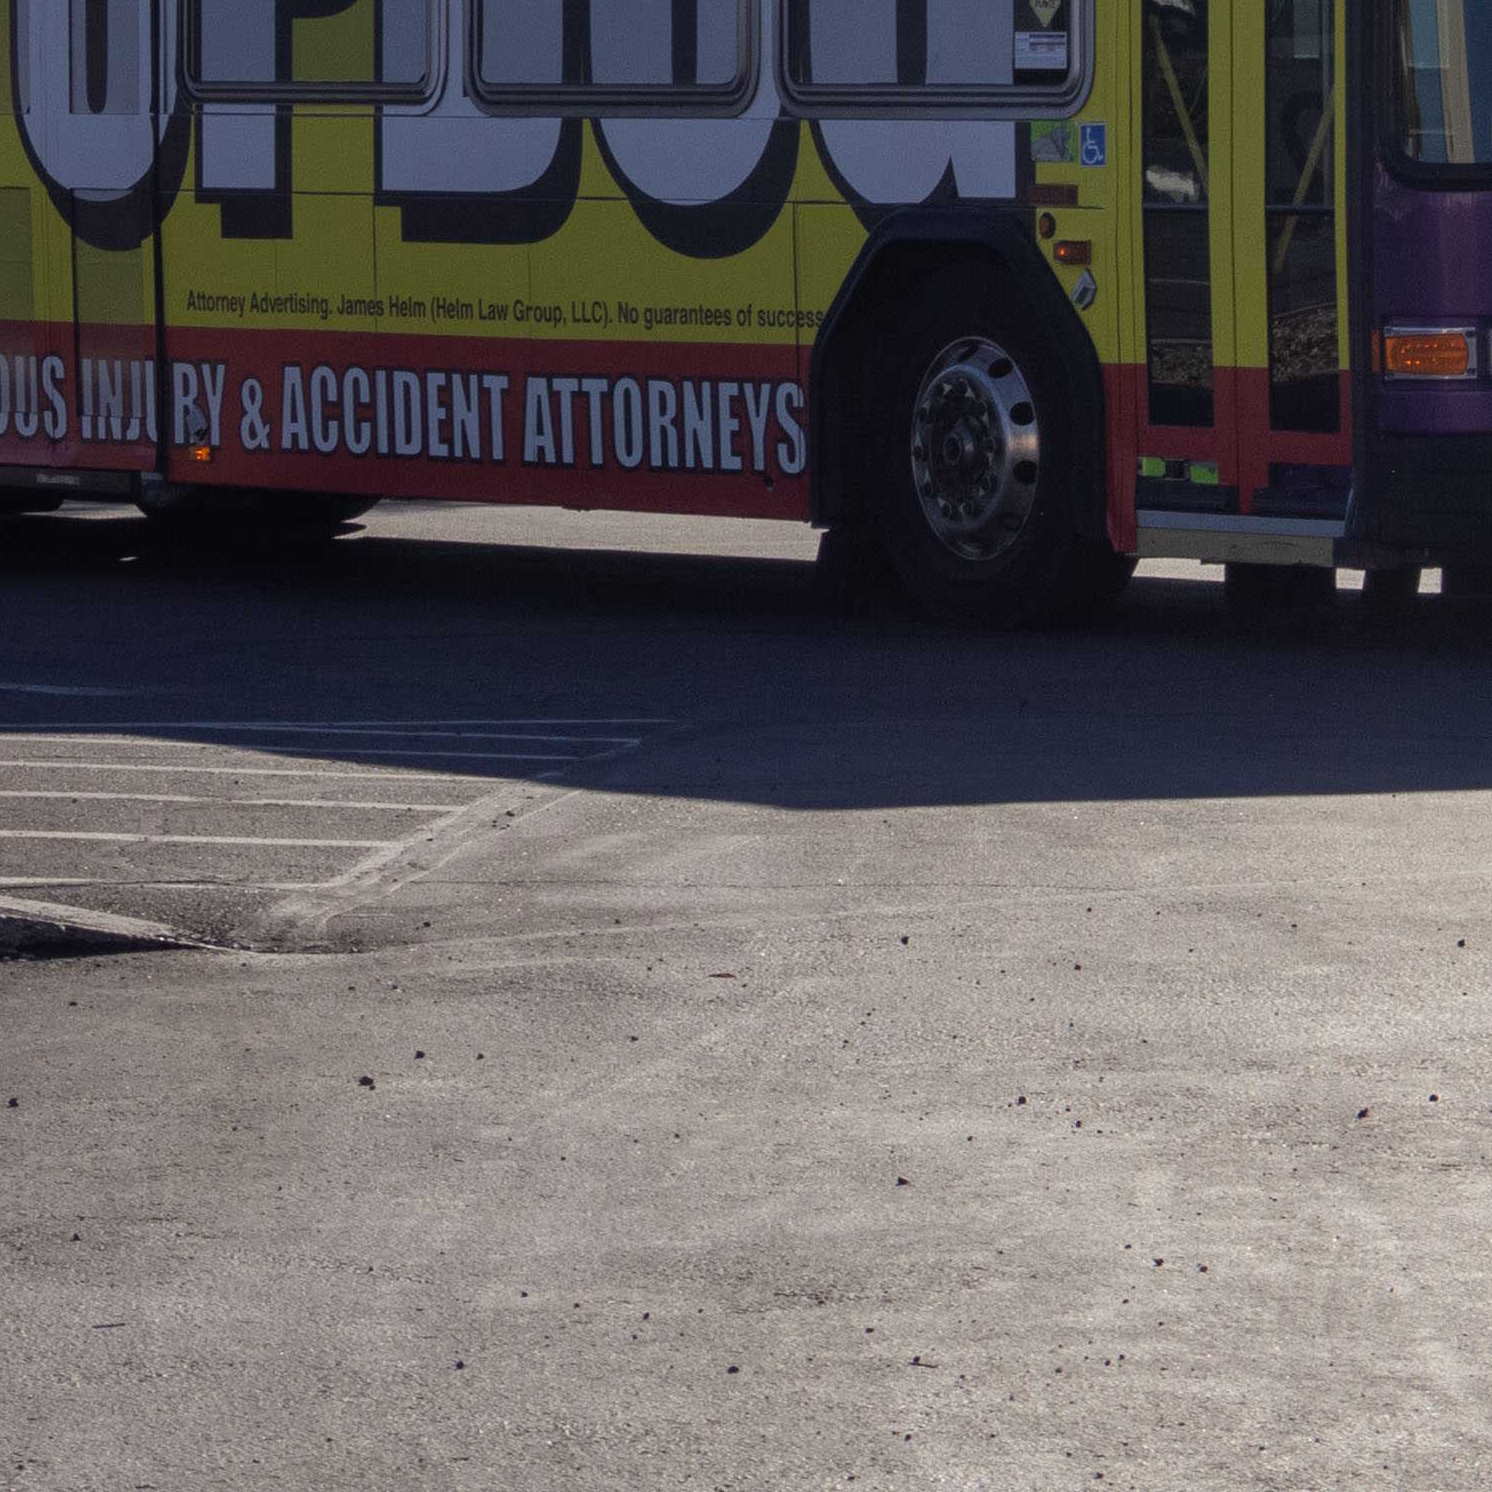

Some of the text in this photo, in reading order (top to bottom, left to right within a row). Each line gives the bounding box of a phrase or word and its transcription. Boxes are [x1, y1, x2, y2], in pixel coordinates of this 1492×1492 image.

[187, 290, 245, 317] Attorney
[250, 292, 332, 319] Advertising.
[337, 294, 384, 317] James
[389, 295, 426, 318] Helm
[430, 296, 473, 323] (Helm
[479, 298, 508, 321] Law
[513, 299, 566, 326] Group,
[572, 300, 613, 327] LLC).
[618, 303, 638, 323] No
[644, 303, 732, 330] guarantees
[737, 304, 753, 326] of
[240, 378, 270, 450] &
[280, 365, 509, 460] ACCIDENT
[522, 376, 808, 475] ATTORNEYS
